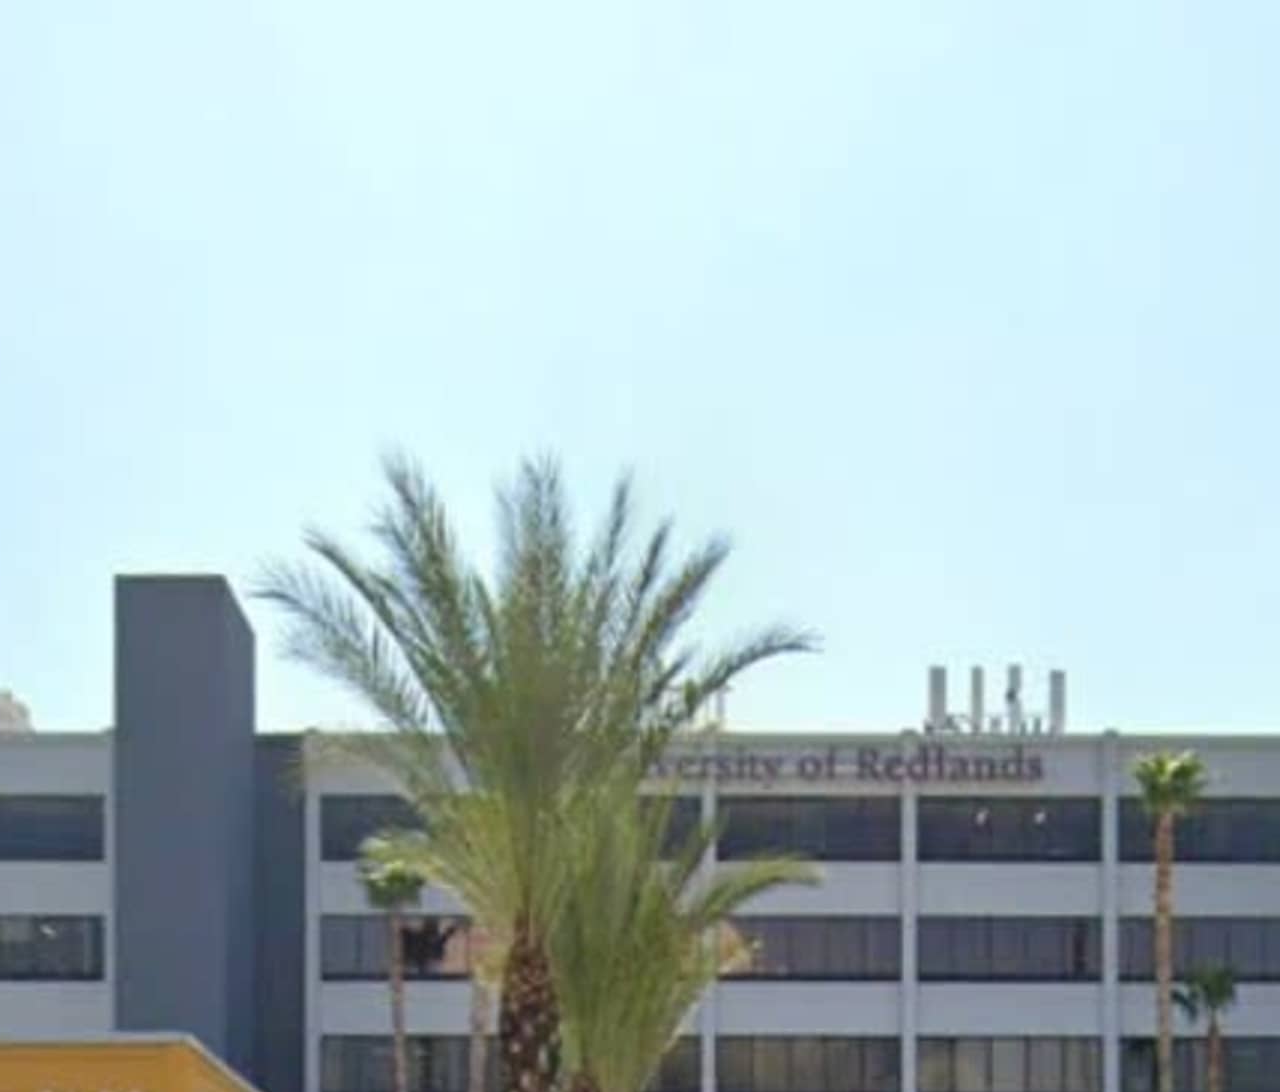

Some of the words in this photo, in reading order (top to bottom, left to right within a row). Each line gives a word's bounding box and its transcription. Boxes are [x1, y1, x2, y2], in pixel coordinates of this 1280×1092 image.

[650, 744, 784, 790] versity
[798, 743, 840, 780] of
[856, 740, 1044, 782] Redlands
